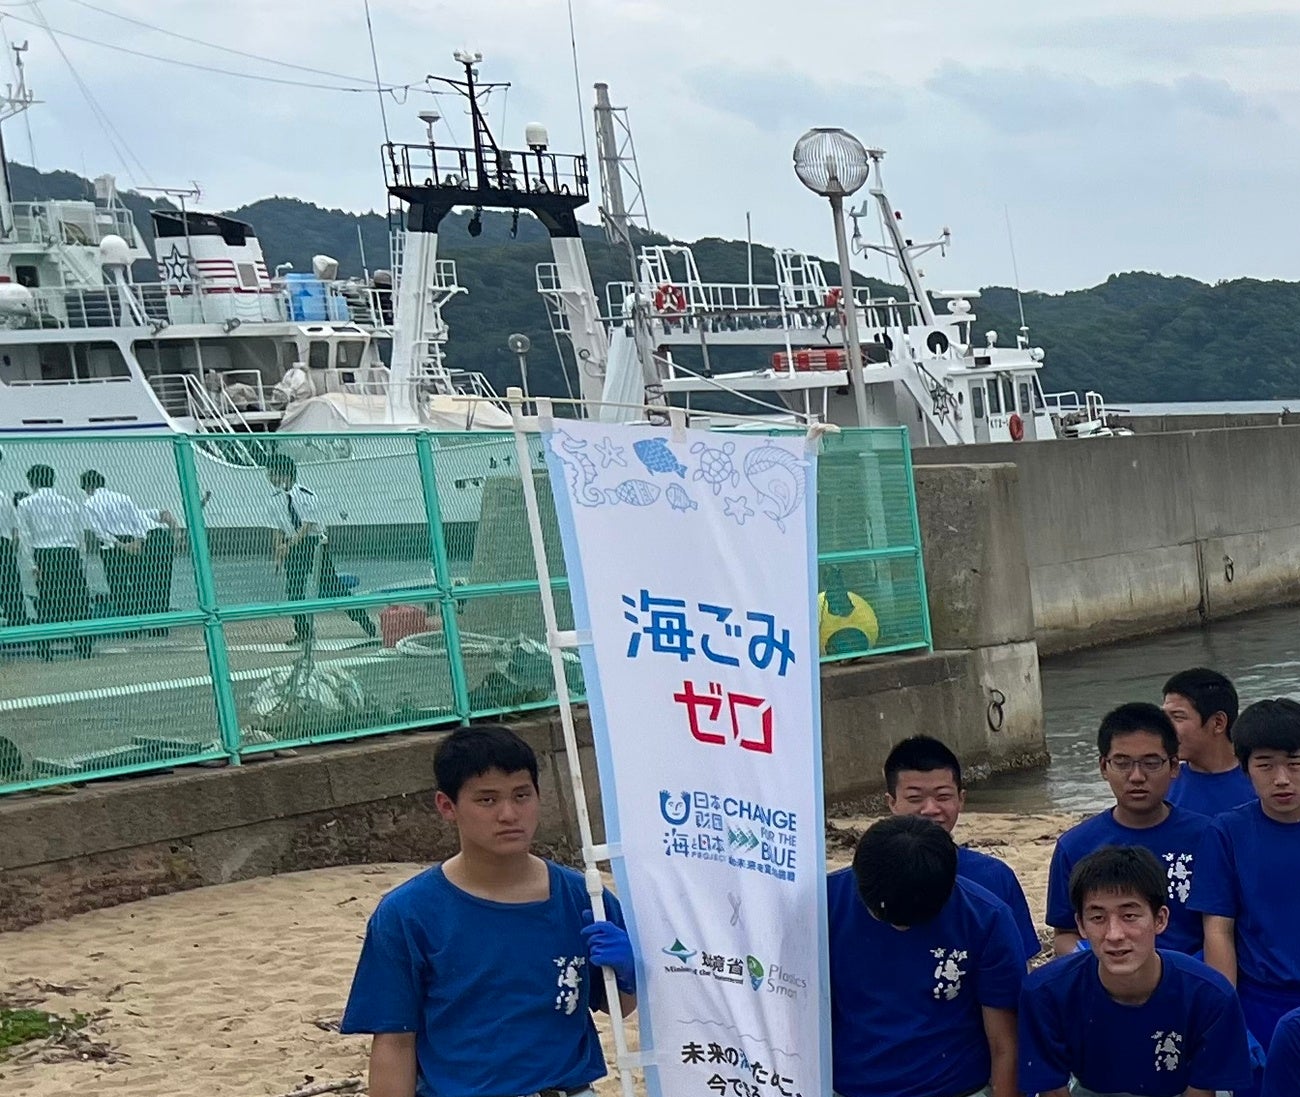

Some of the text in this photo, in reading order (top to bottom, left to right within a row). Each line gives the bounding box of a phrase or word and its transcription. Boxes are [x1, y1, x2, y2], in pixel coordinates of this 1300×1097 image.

[622, 589, 796, 676] 海ごみ
[673, 680, 773, 754] ゼロ
[694, 791, 721, 811] 日本
[723, 797, 797, 831] CHANGE
[778, 832, 796, 847] THE
